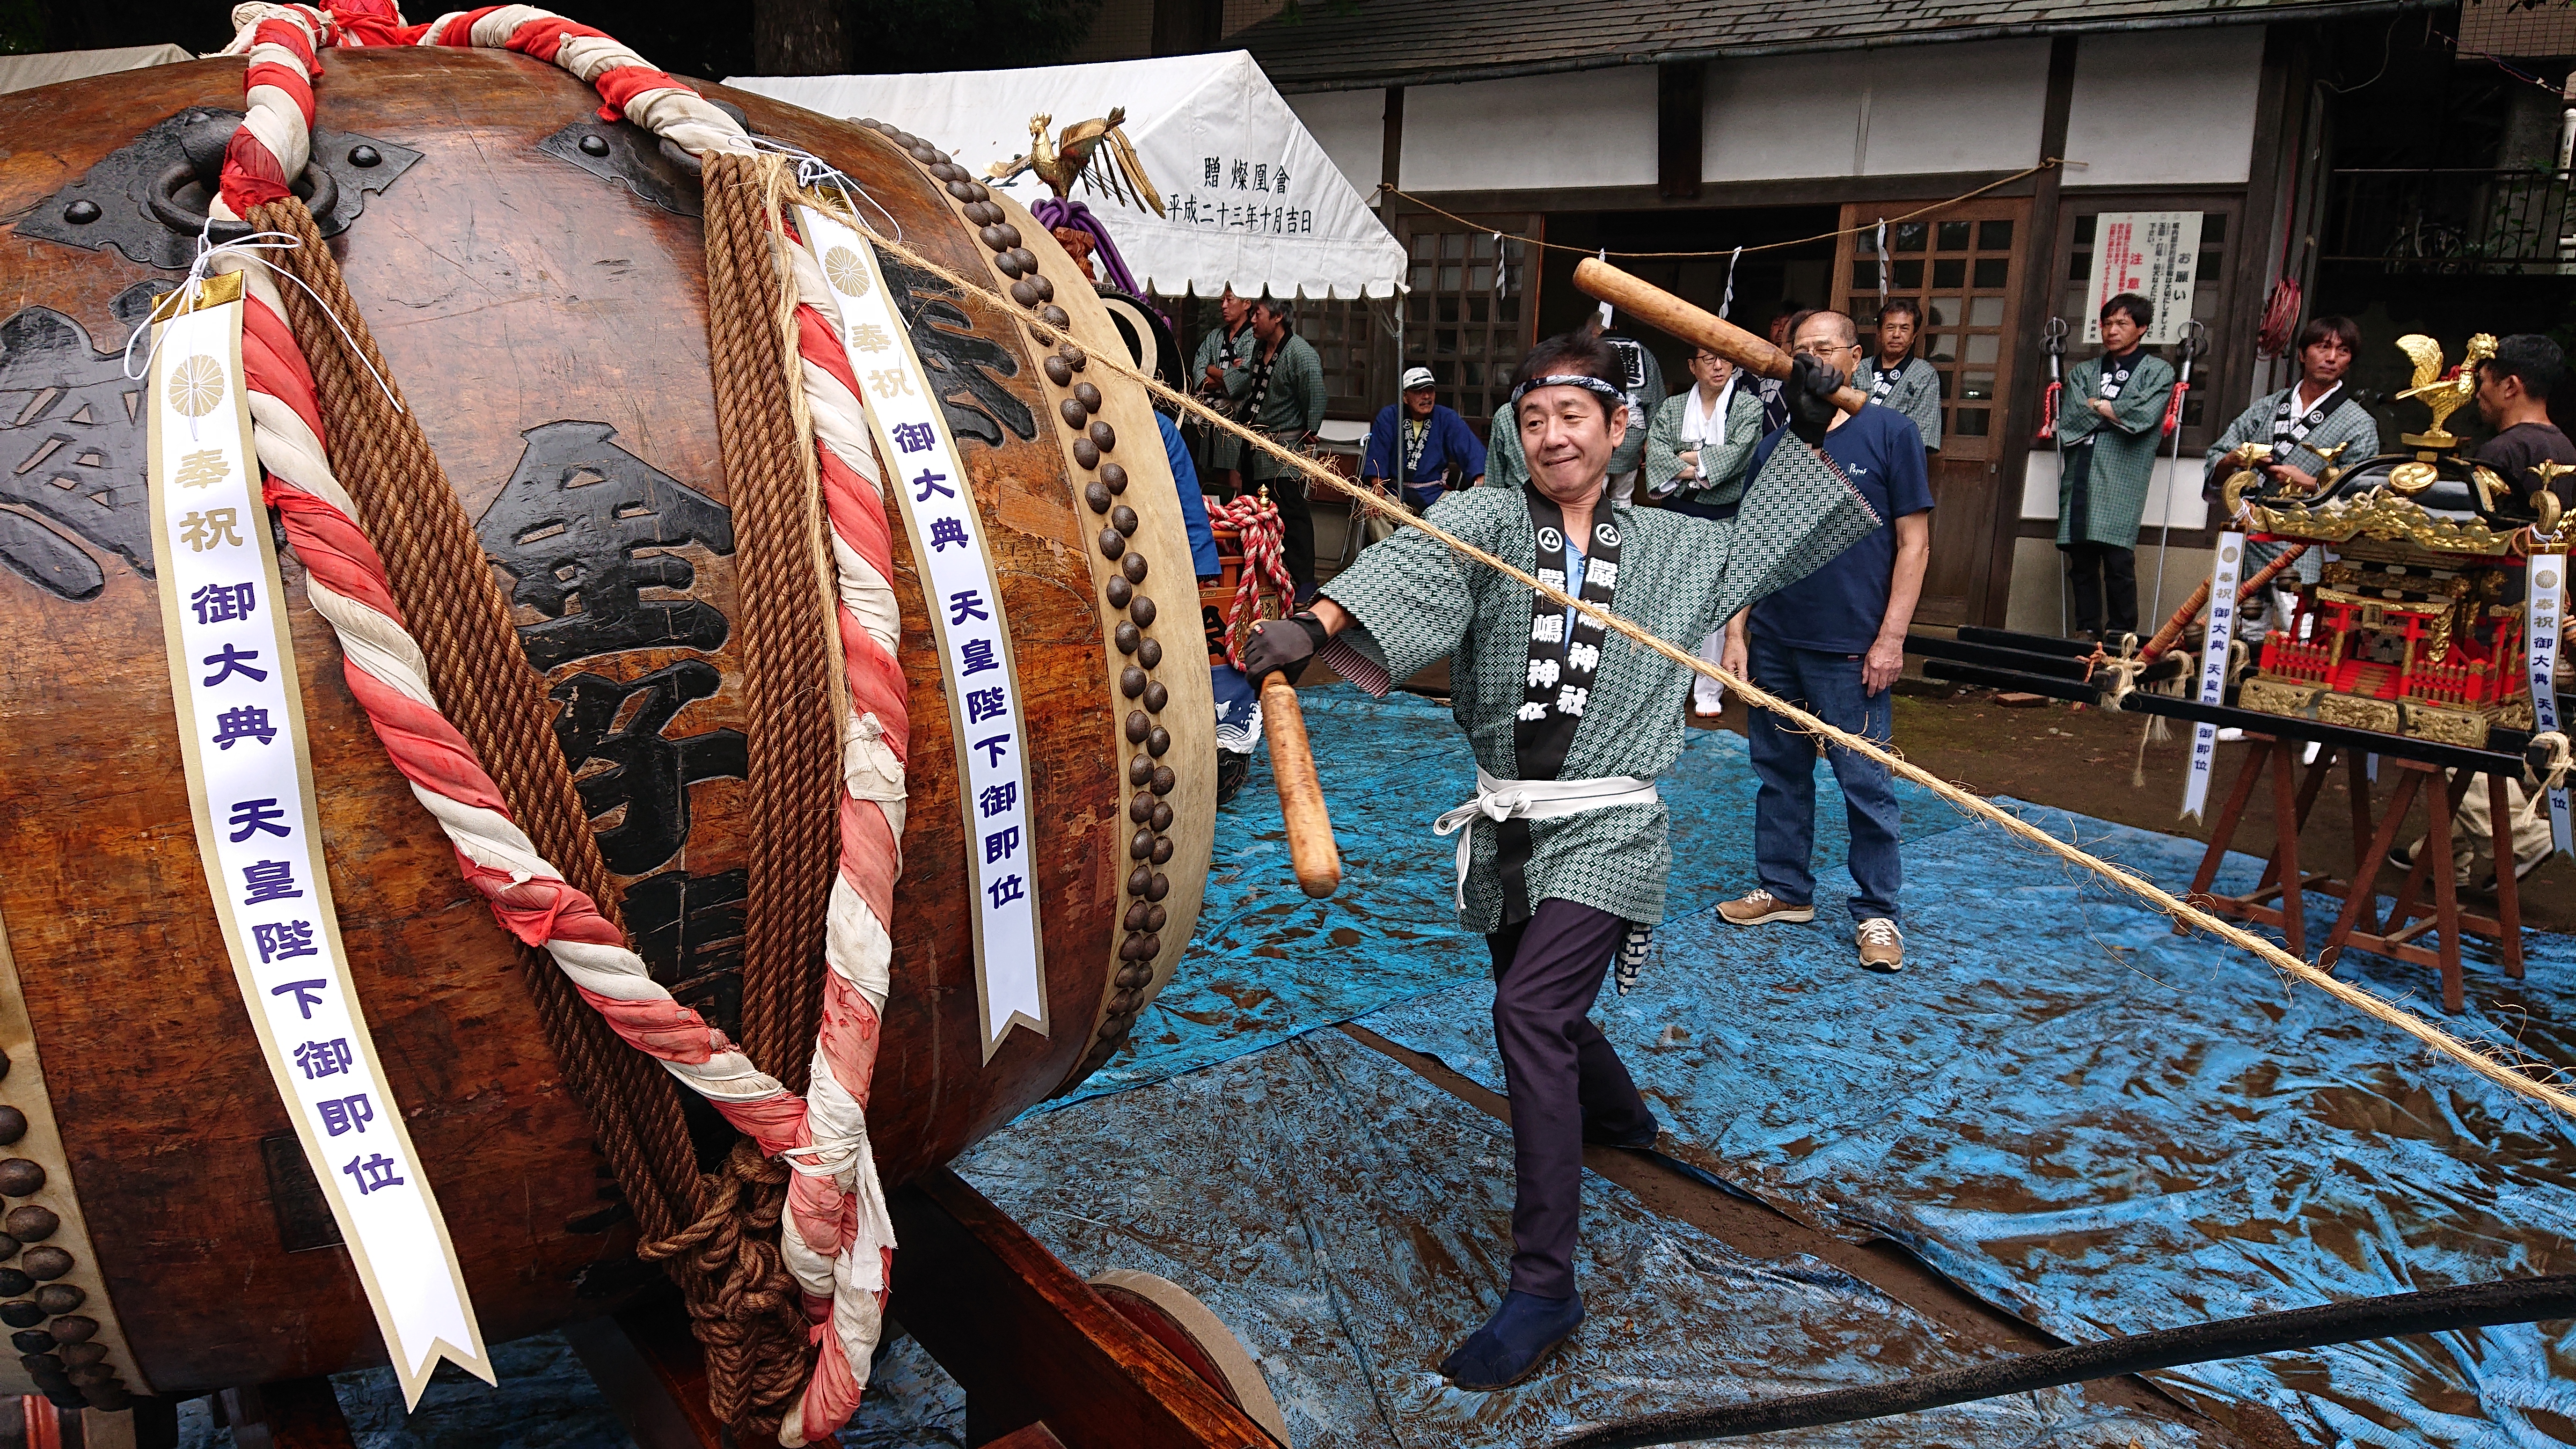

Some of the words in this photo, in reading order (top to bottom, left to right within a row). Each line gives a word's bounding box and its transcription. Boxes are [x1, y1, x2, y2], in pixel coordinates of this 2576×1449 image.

[1167, 194, 1311, 234] 平成二十三年十月吉日
[2174, 252, 2191, 300] お願い
[175, 448, 242, 552] 奉祝
[2216, 571, 2234, 600] 奉祝
[852, 323, 914, 398] 奉祝
[893, 422, 968, 552] 御大典
[950, 590, 1024, 909] 天皇陛下御即位
[2210, 607, 2230, 651] 御大典
[2533, 599, 2555, 628] 奉祝
[191, 582, 277, 750] 御大典
[2532, 637, 2553, 685] 御大典
[228, 798, 403, 1195] 天皇陛下御即位
